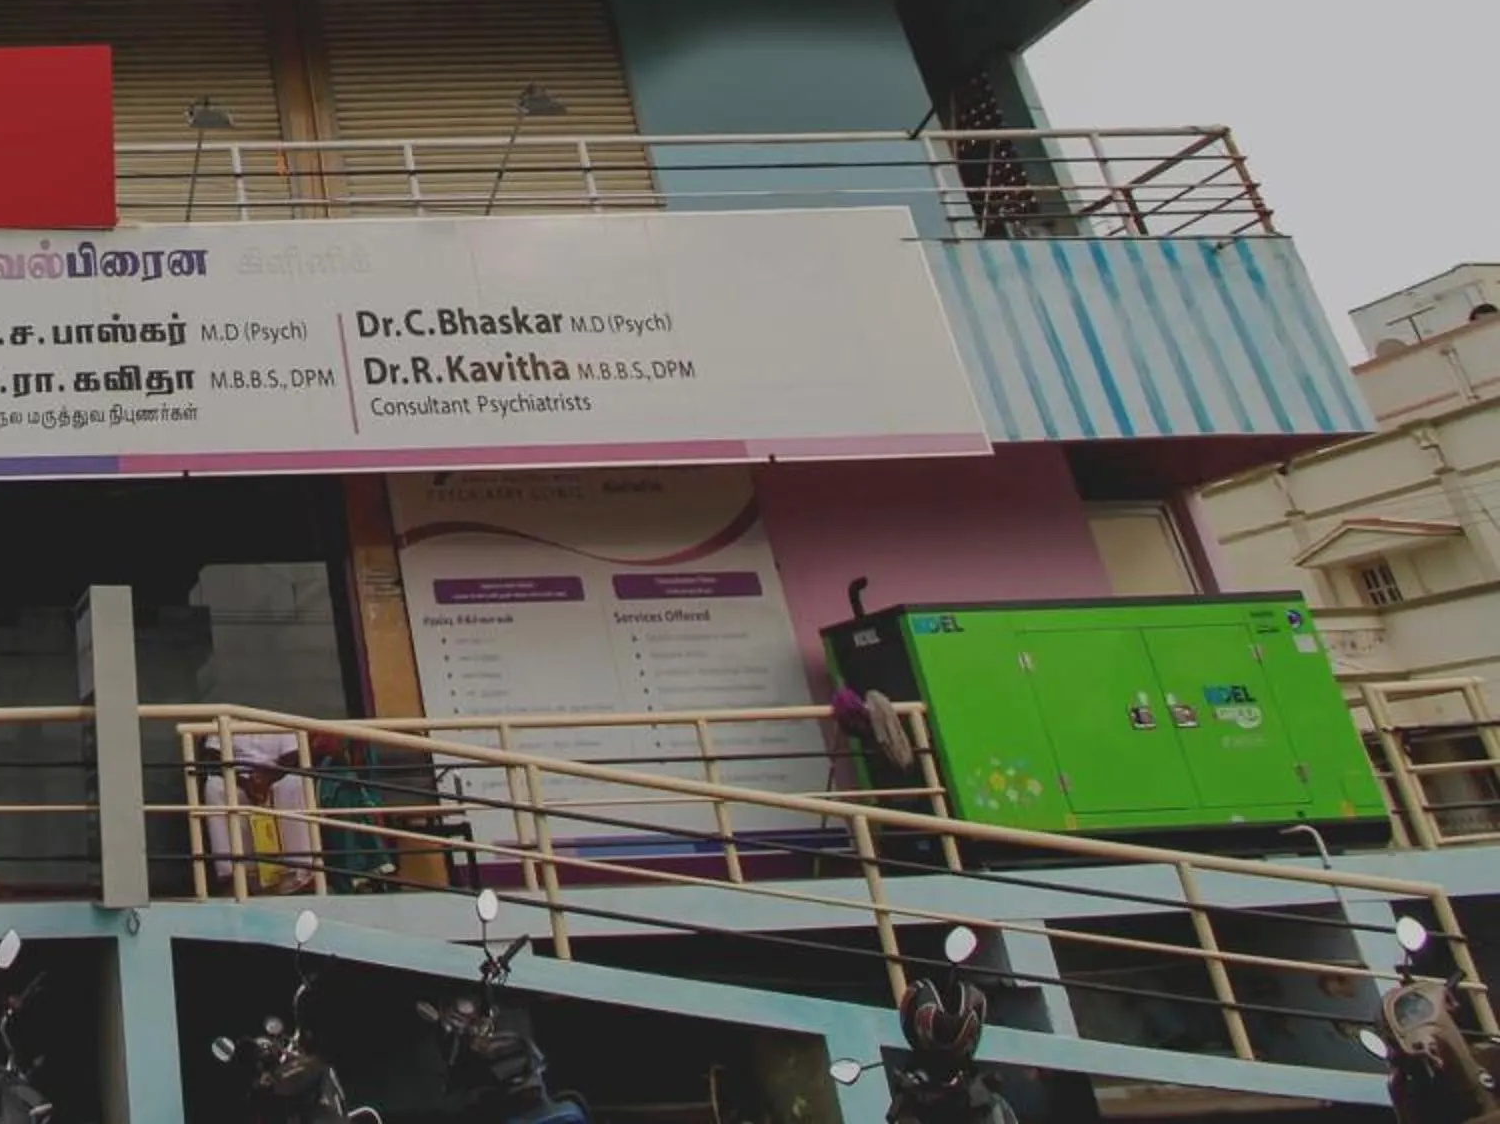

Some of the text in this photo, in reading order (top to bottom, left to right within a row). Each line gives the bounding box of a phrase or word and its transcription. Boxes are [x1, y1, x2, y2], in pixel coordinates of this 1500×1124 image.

[371, 393, 592, 420] Consultant Psychiatrists
[612, 608, 711, 625] Services Offered
